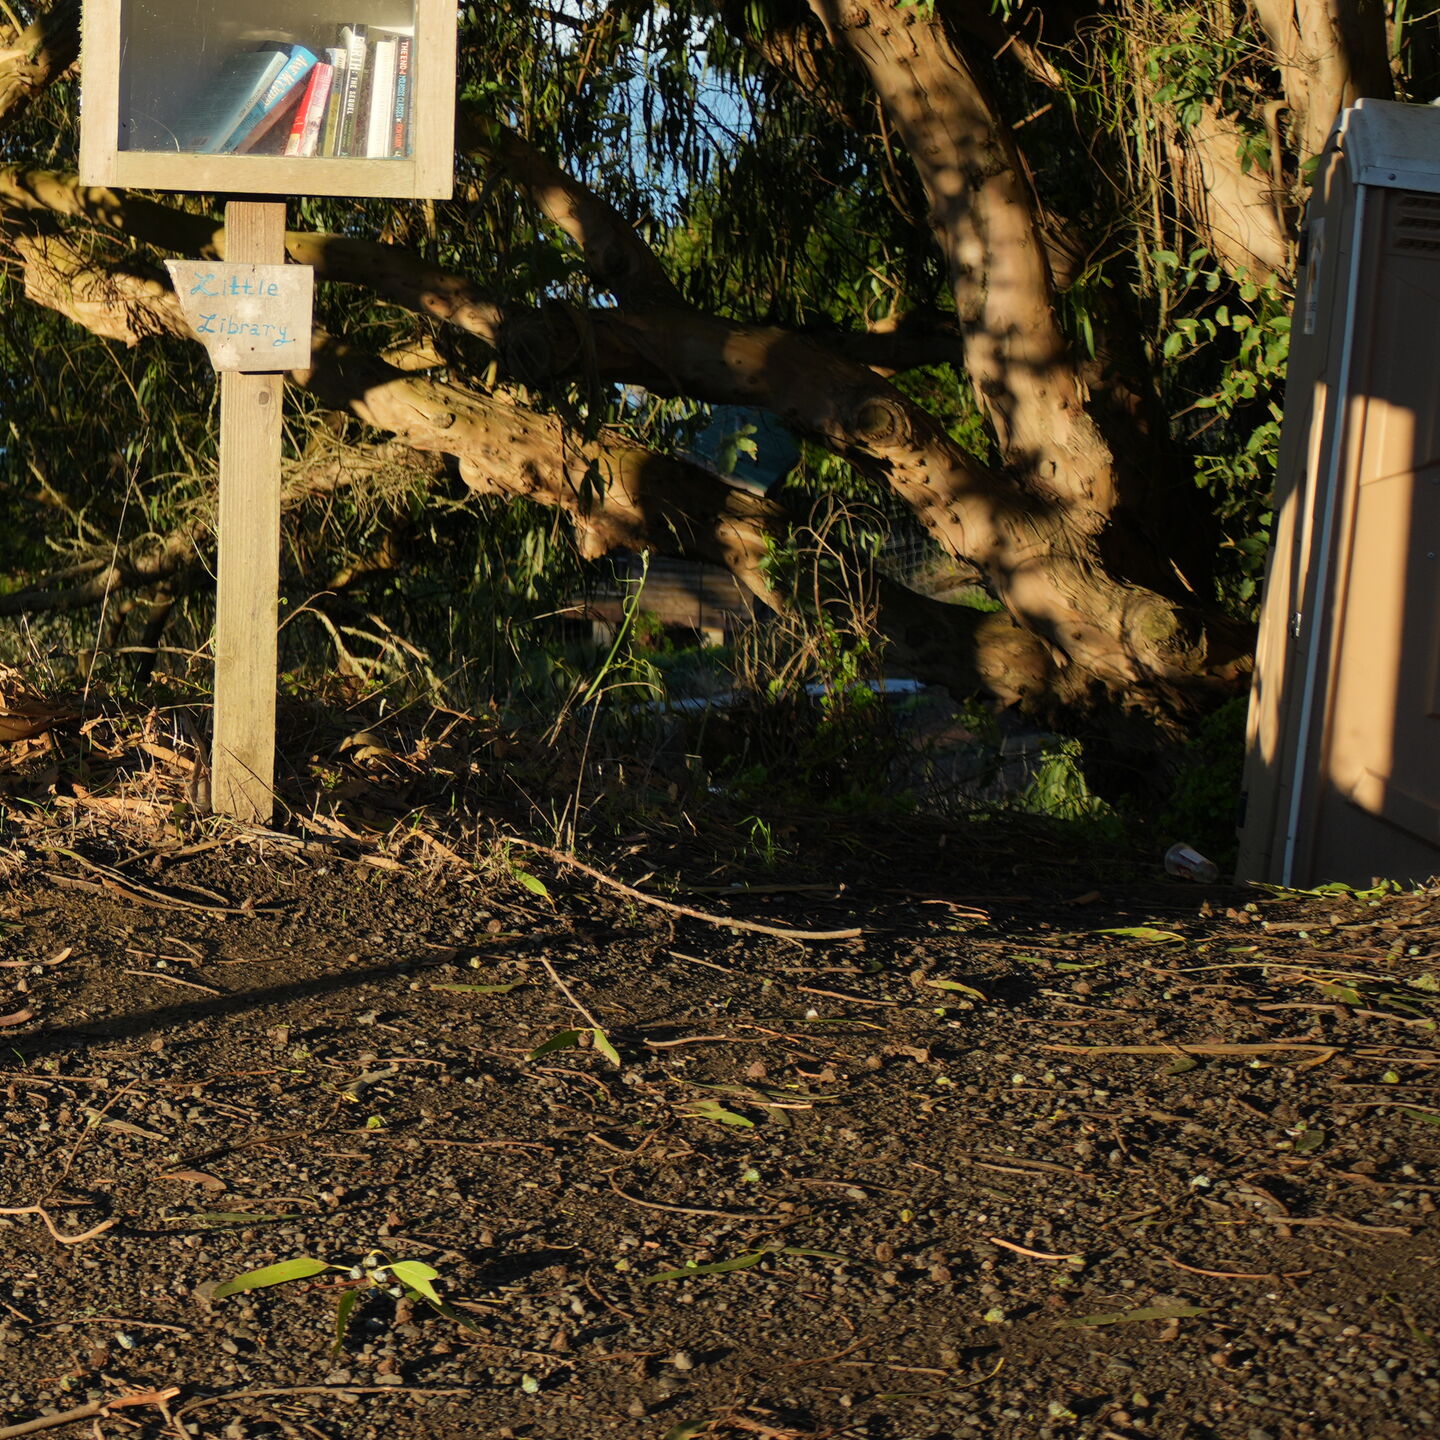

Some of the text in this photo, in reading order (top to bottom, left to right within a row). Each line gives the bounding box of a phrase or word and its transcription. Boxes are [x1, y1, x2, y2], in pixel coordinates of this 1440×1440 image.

[347, 91, 356, 114] SEQUEL
[191, 272, 279, 296] Little
[197, 314, 293, 347] Library
